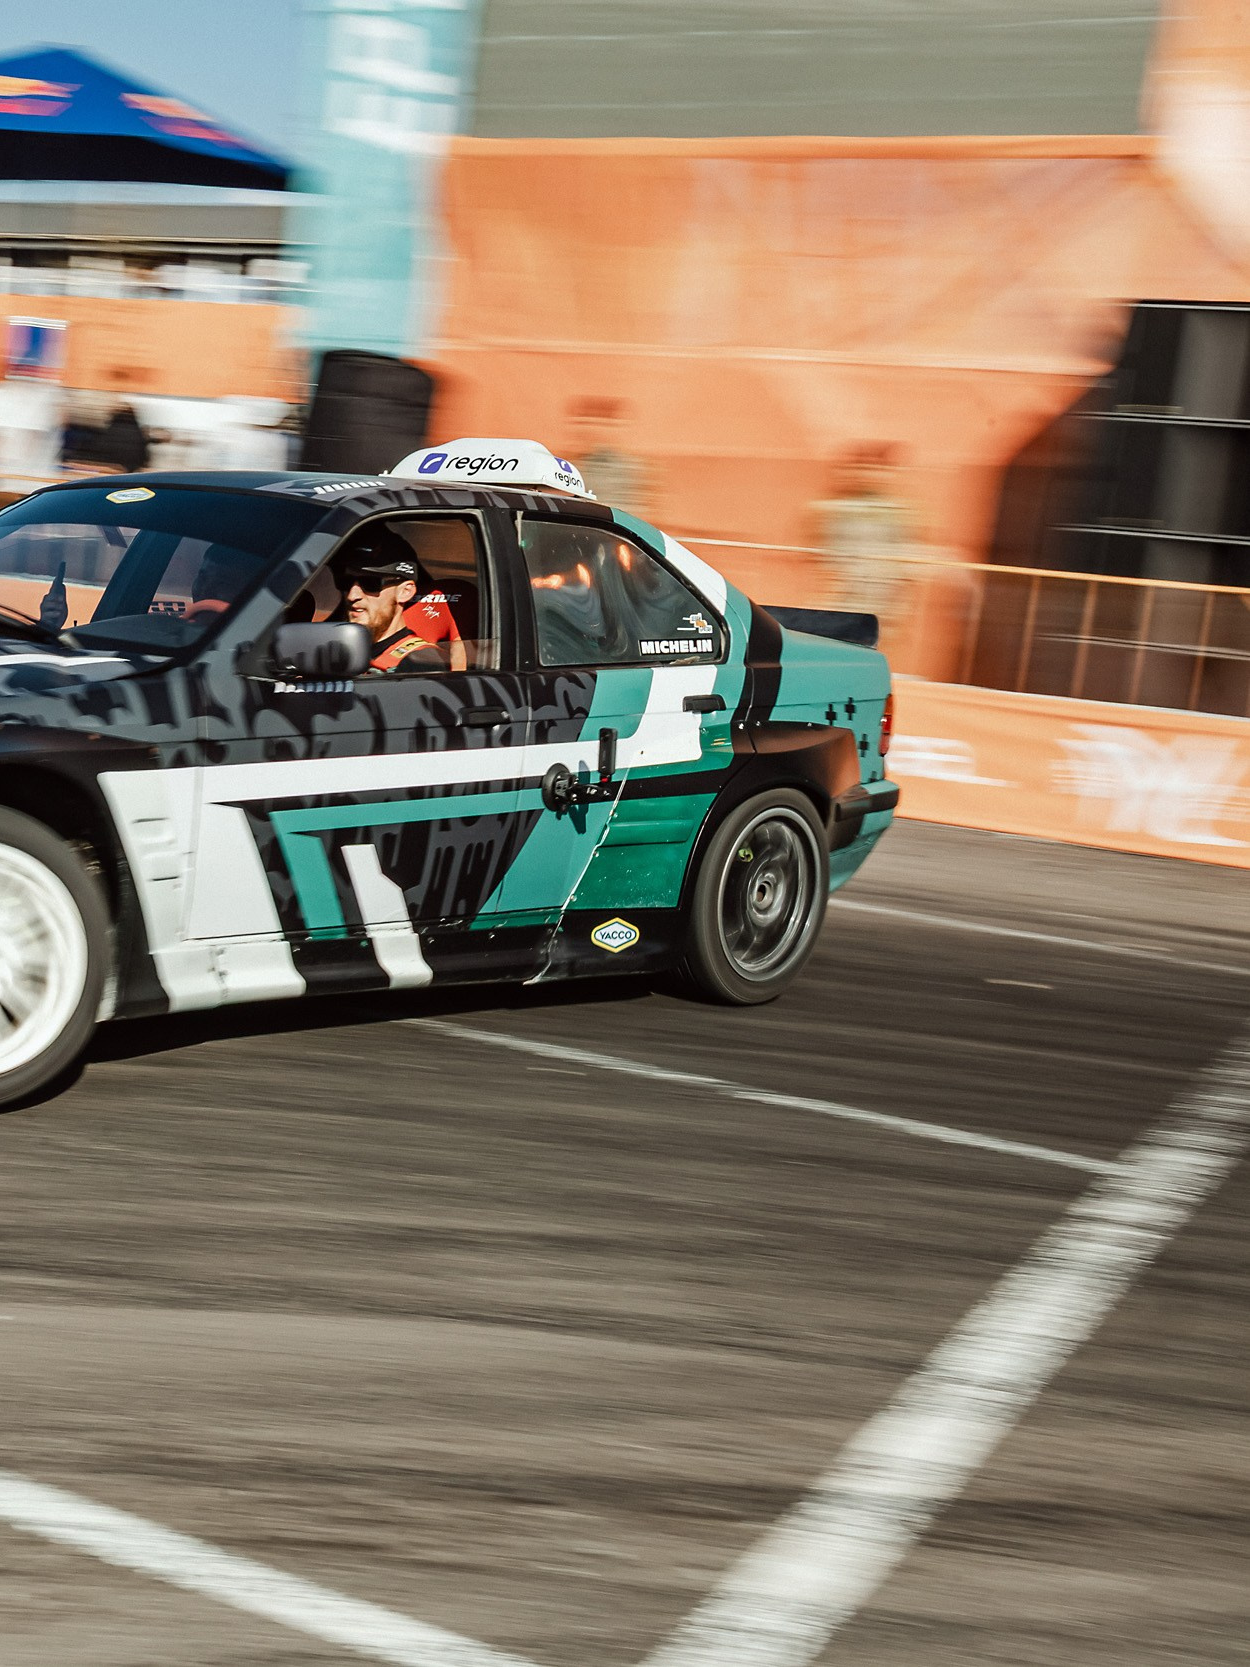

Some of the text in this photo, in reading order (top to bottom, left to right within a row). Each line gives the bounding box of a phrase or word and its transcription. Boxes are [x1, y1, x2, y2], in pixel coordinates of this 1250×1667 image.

[446, 453, 519, 476] region
[554, 471, 583, 487] region
[641, 640, 713, 655] MICHELIN
[599, 930, 632, 940] YACCO
